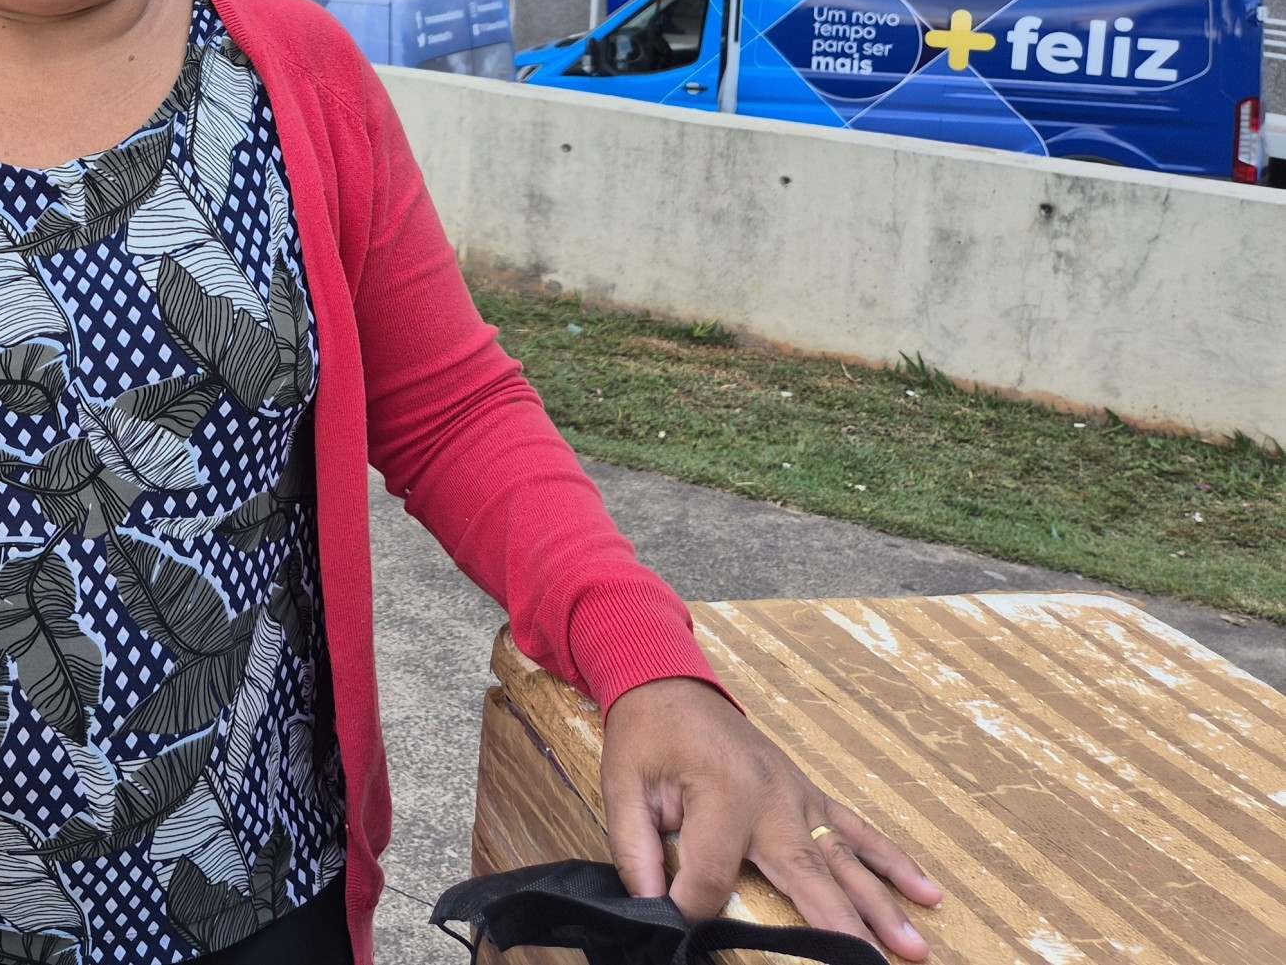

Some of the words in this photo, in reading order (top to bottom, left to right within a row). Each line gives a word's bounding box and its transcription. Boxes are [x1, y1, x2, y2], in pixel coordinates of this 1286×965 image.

[814, 6, 847, 24] Um
[852, 11, 900, 27] novo
[813, 21, 876, 42] tempo
[812, 38, 858, 55] para
[862, 42, 893, 57] ser
[1007, 15, 1180, 82] feliz
[811, 52, 873, 76] mais
